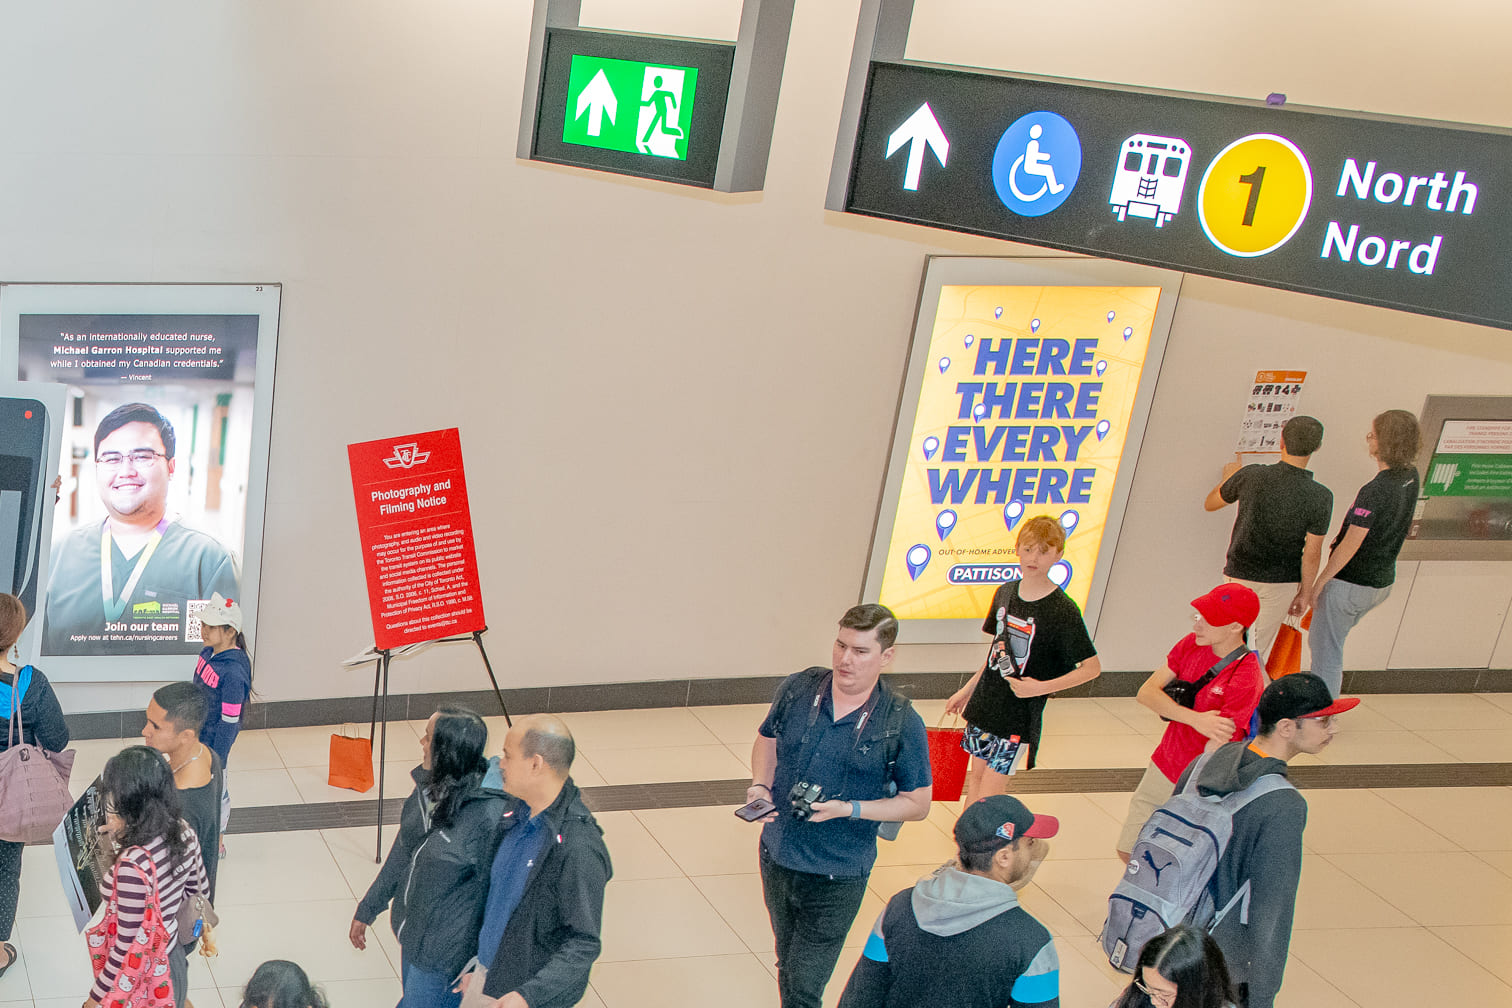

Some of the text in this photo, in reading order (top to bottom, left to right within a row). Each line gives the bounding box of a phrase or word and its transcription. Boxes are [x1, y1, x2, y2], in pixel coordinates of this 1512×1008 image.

[1239, 166, 1266, 226] 1
[1336, 158, 1479, 214] North
[1320, 221, 1443, 275] Nord
[53, 346, 88, 354] Michael
[126, 346, 162, 355] Hospital
[166, 347, 206, 356] supported
[90, 332, 147, 342] internationally
[150, 333, 187, 341] educated
[190, 334, 216, 342] nurse,
[50, 360, 72, 368] while
[81, 360, 116, 368] obtained
[134, 360, 170, 368] Canadian
[973, 338, 1099, 376] HERE
[956, 382, 1104, 420] THERE
[942, 426, 1095, 462] EVERY
[370, 478, 451, 502] Photography and
[926, 468, 1096, 504] WHERE
[379, 495, 447, 516] Filming Notice
[954, 568, 1024, 580] PATTISON
[104, 622, 179, 631] Join our team
